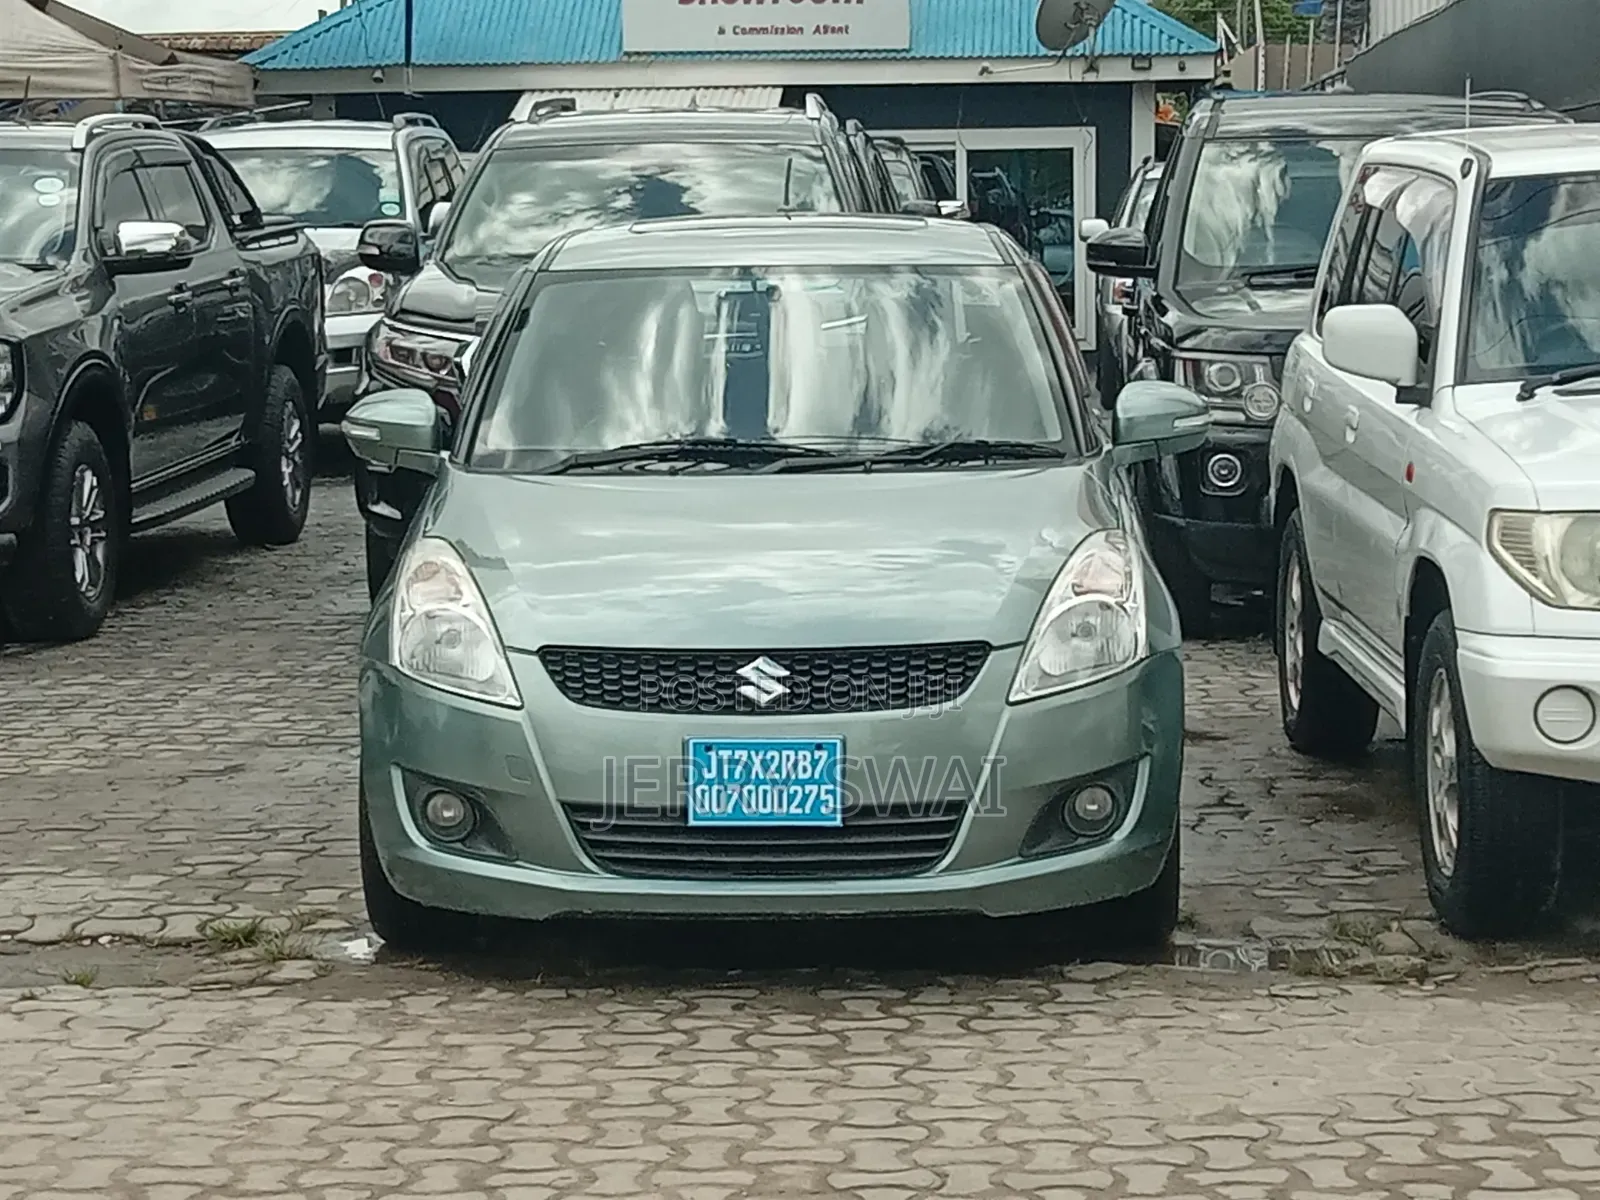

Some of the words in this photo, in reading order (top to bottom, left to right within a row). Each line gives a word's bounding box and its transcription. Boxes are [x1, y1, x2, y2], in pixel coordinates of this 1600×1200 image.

[732, 24, 804, 36] Commission
[702, 749, 828, 780] JT7X2RB7
[694, 783, 835, 816] 007000275
